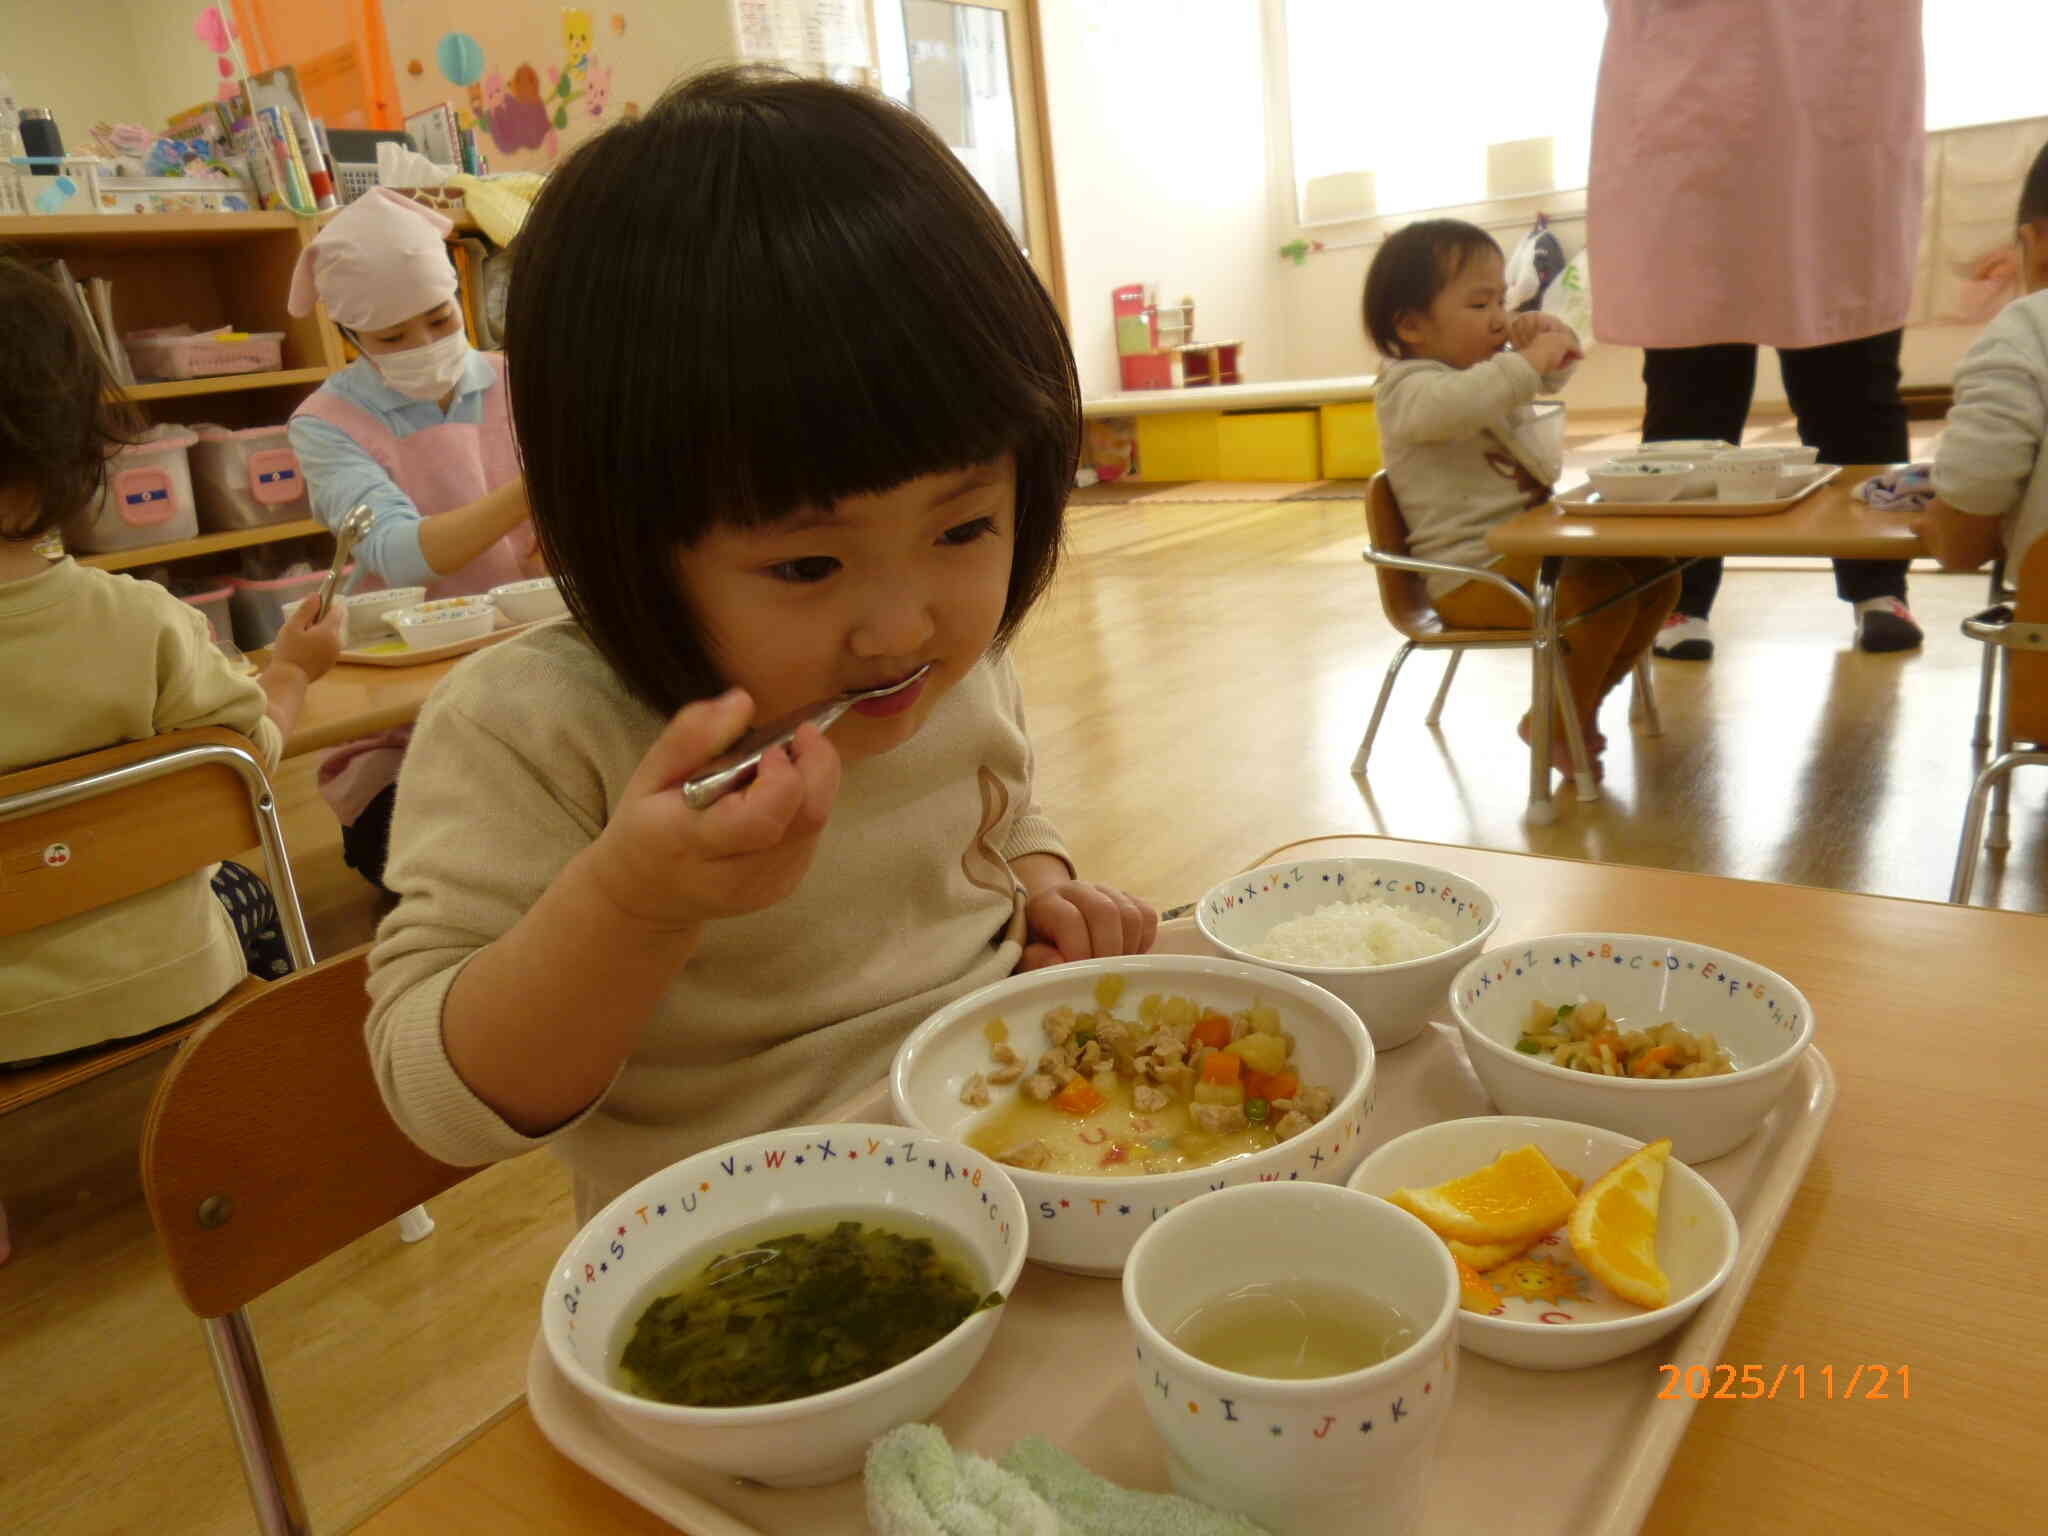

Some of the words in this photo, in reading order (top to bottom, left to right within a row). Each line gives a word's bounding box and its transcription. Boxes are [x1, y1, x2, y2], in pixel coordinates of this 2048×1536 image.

[1244, 882, 1257, 899] X
[1269, 873, 1280, 886] Y
[1290, 866, 1304, 883] Z
[1386, 879, 1400, 893] C
[1414, 879, 1426, 895] D
[1440, 885, 1453, 902] E
[1456, 902, 1466, 917] F
[1480, 970, 1492, 990] X
[1523, 949, 1539, 968] Z
[1570, 952, 1583, 969] A
[1600, 943, 1613, 960] B
[1630, 955, 1644, 970] C
[1666, 955, 1680, 971] D
[1701, 961, 1718, 979] E
[1729, 980, 1741, 997] F
[1040, 1202, 1056, 1219] S
[1088, 1199, 1107, 1217] T
[1309, 1147, 1325, 1169] X
[563, 1293, 578, 1315] Q
[584, 1263, 596, 1283] R
[610, 1240, 625, 1261] S
[634, 1205, 650, 1225] T
[681, 1191, 697, 1213] U
[720, 1155, 735, 1177] V
[764, 1150, 786, 1169] W
[816, 1139, 837, 1161] X
[867, 1138, 881, 1156] Y
[902, 1142, 919, 1163] Z
[944, 1161, 956, 1182] A
[971, 1167, 983, 1188] B
[1219, 1397, 1239, 1422] I
[1313, 1416, 1336, 1439] J
[1391, 1397, 1409, 1423] K
